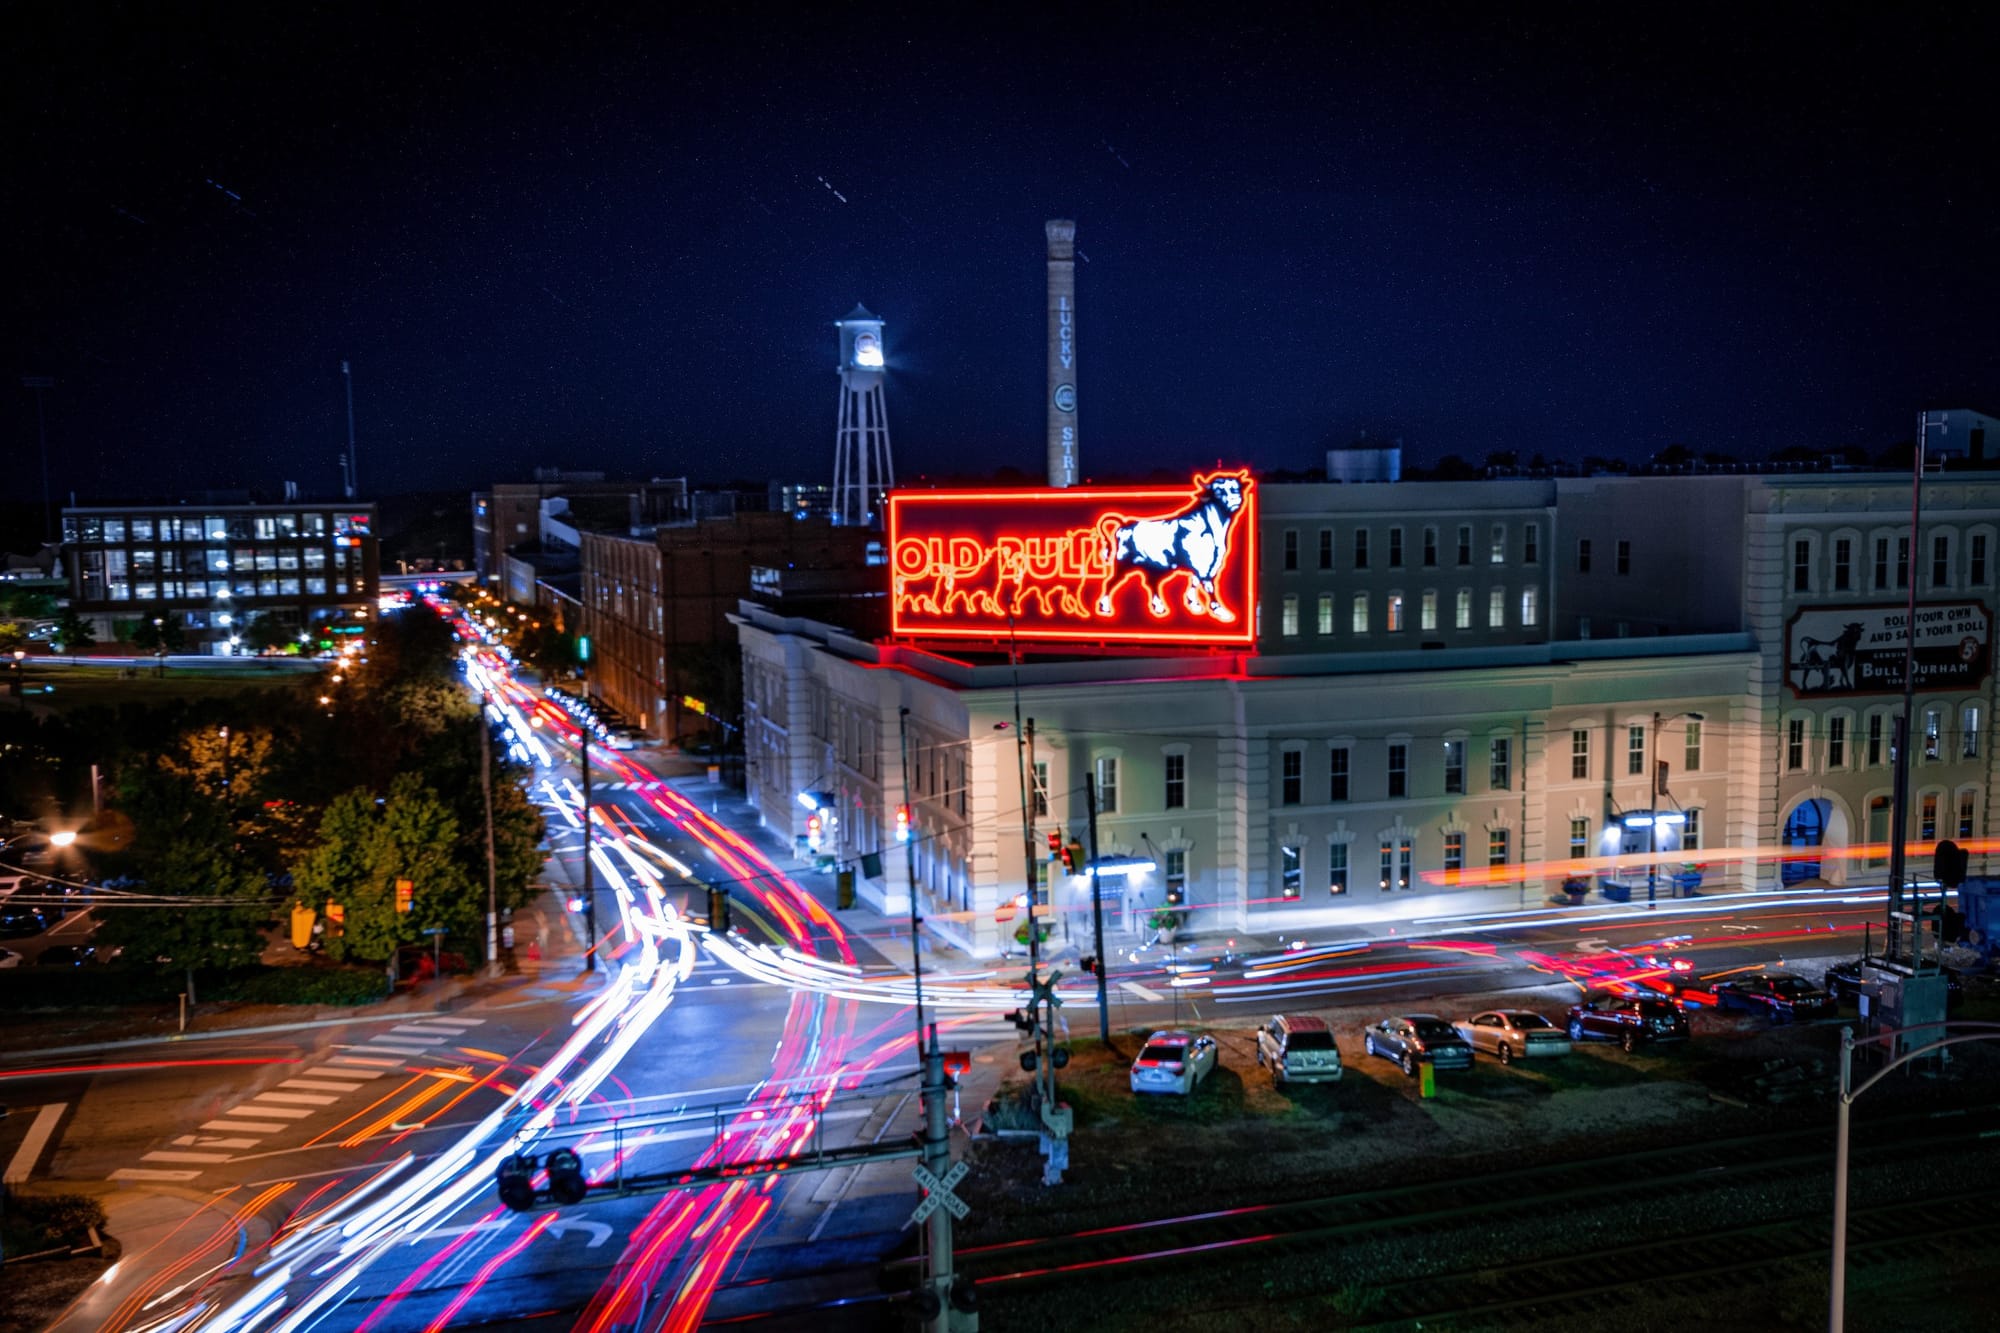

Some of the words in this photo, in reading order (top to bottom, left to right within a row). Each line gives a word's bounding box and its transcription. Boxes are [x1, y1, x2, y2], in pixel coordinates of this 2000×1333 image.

[1060, 297, 1072, 368] LUCKY
[1061, 427, 1074, 487] STRI
[895, 537, 983, 580] OLD
[998, 537, 1111, 579] BULL
[1916, 611, 1944, 622] YOUR
[1948, 608, 1971, 620] OWN
[1870, 631, 1892, 643] AND
[1896, 628, 1921, 640] SAE
[1926, 625, 1952, 636] YOUR
[1957, 621, 1984, 633] ROLL
[1873, 651, 1908, 659] GENUIN
[1887, 676, 1926, 685] TOBCO
